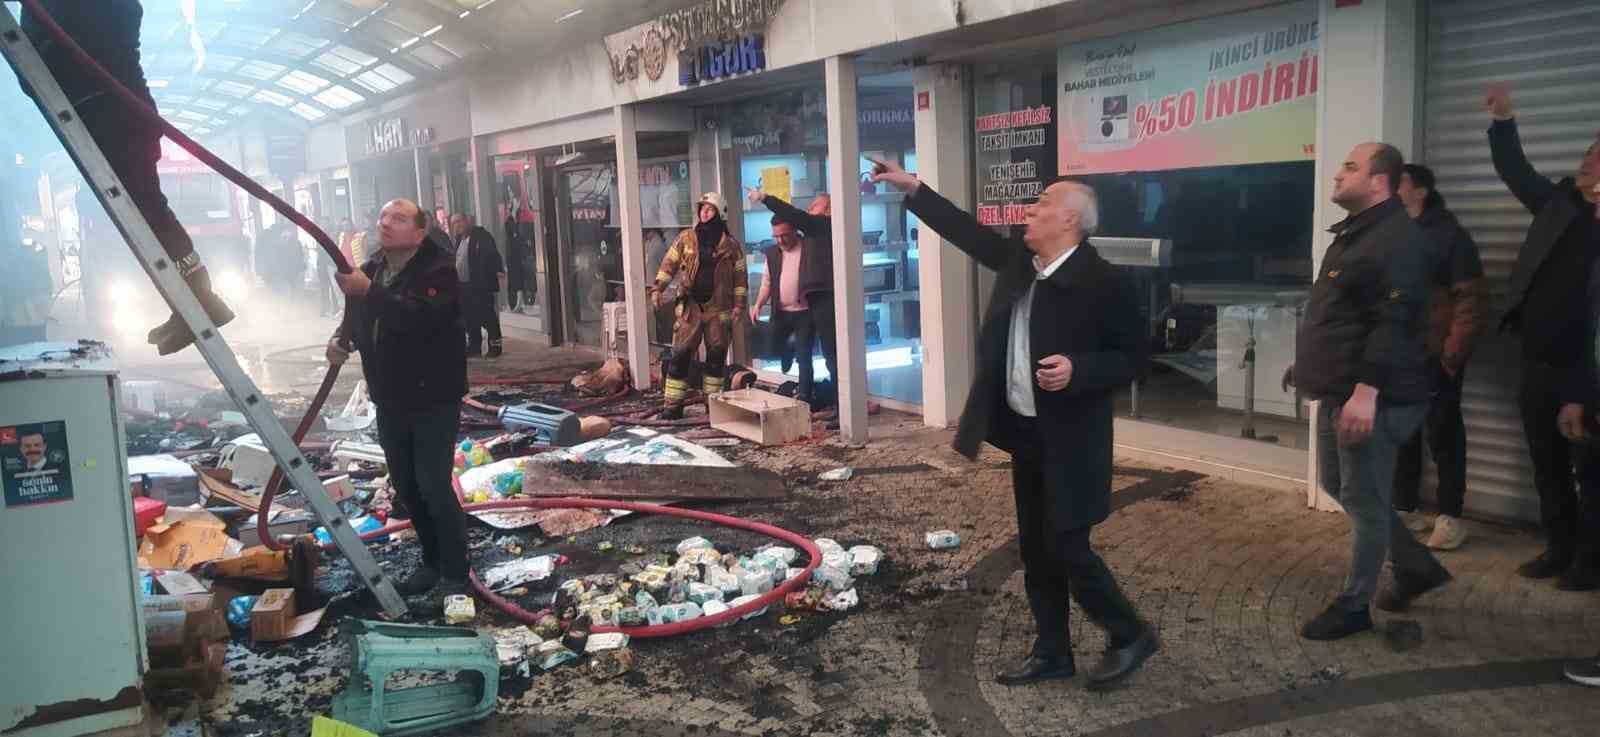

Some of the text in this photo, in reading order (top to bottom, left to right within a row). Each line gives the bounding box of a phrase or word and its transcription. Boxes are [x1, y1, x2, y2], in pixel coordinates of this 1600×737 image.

[1064, 78, 1097, 93] BAHAR
[1135, 88, 1197, 140] %50
[977, 201, 1026, 225] ÖZEL FİYA
